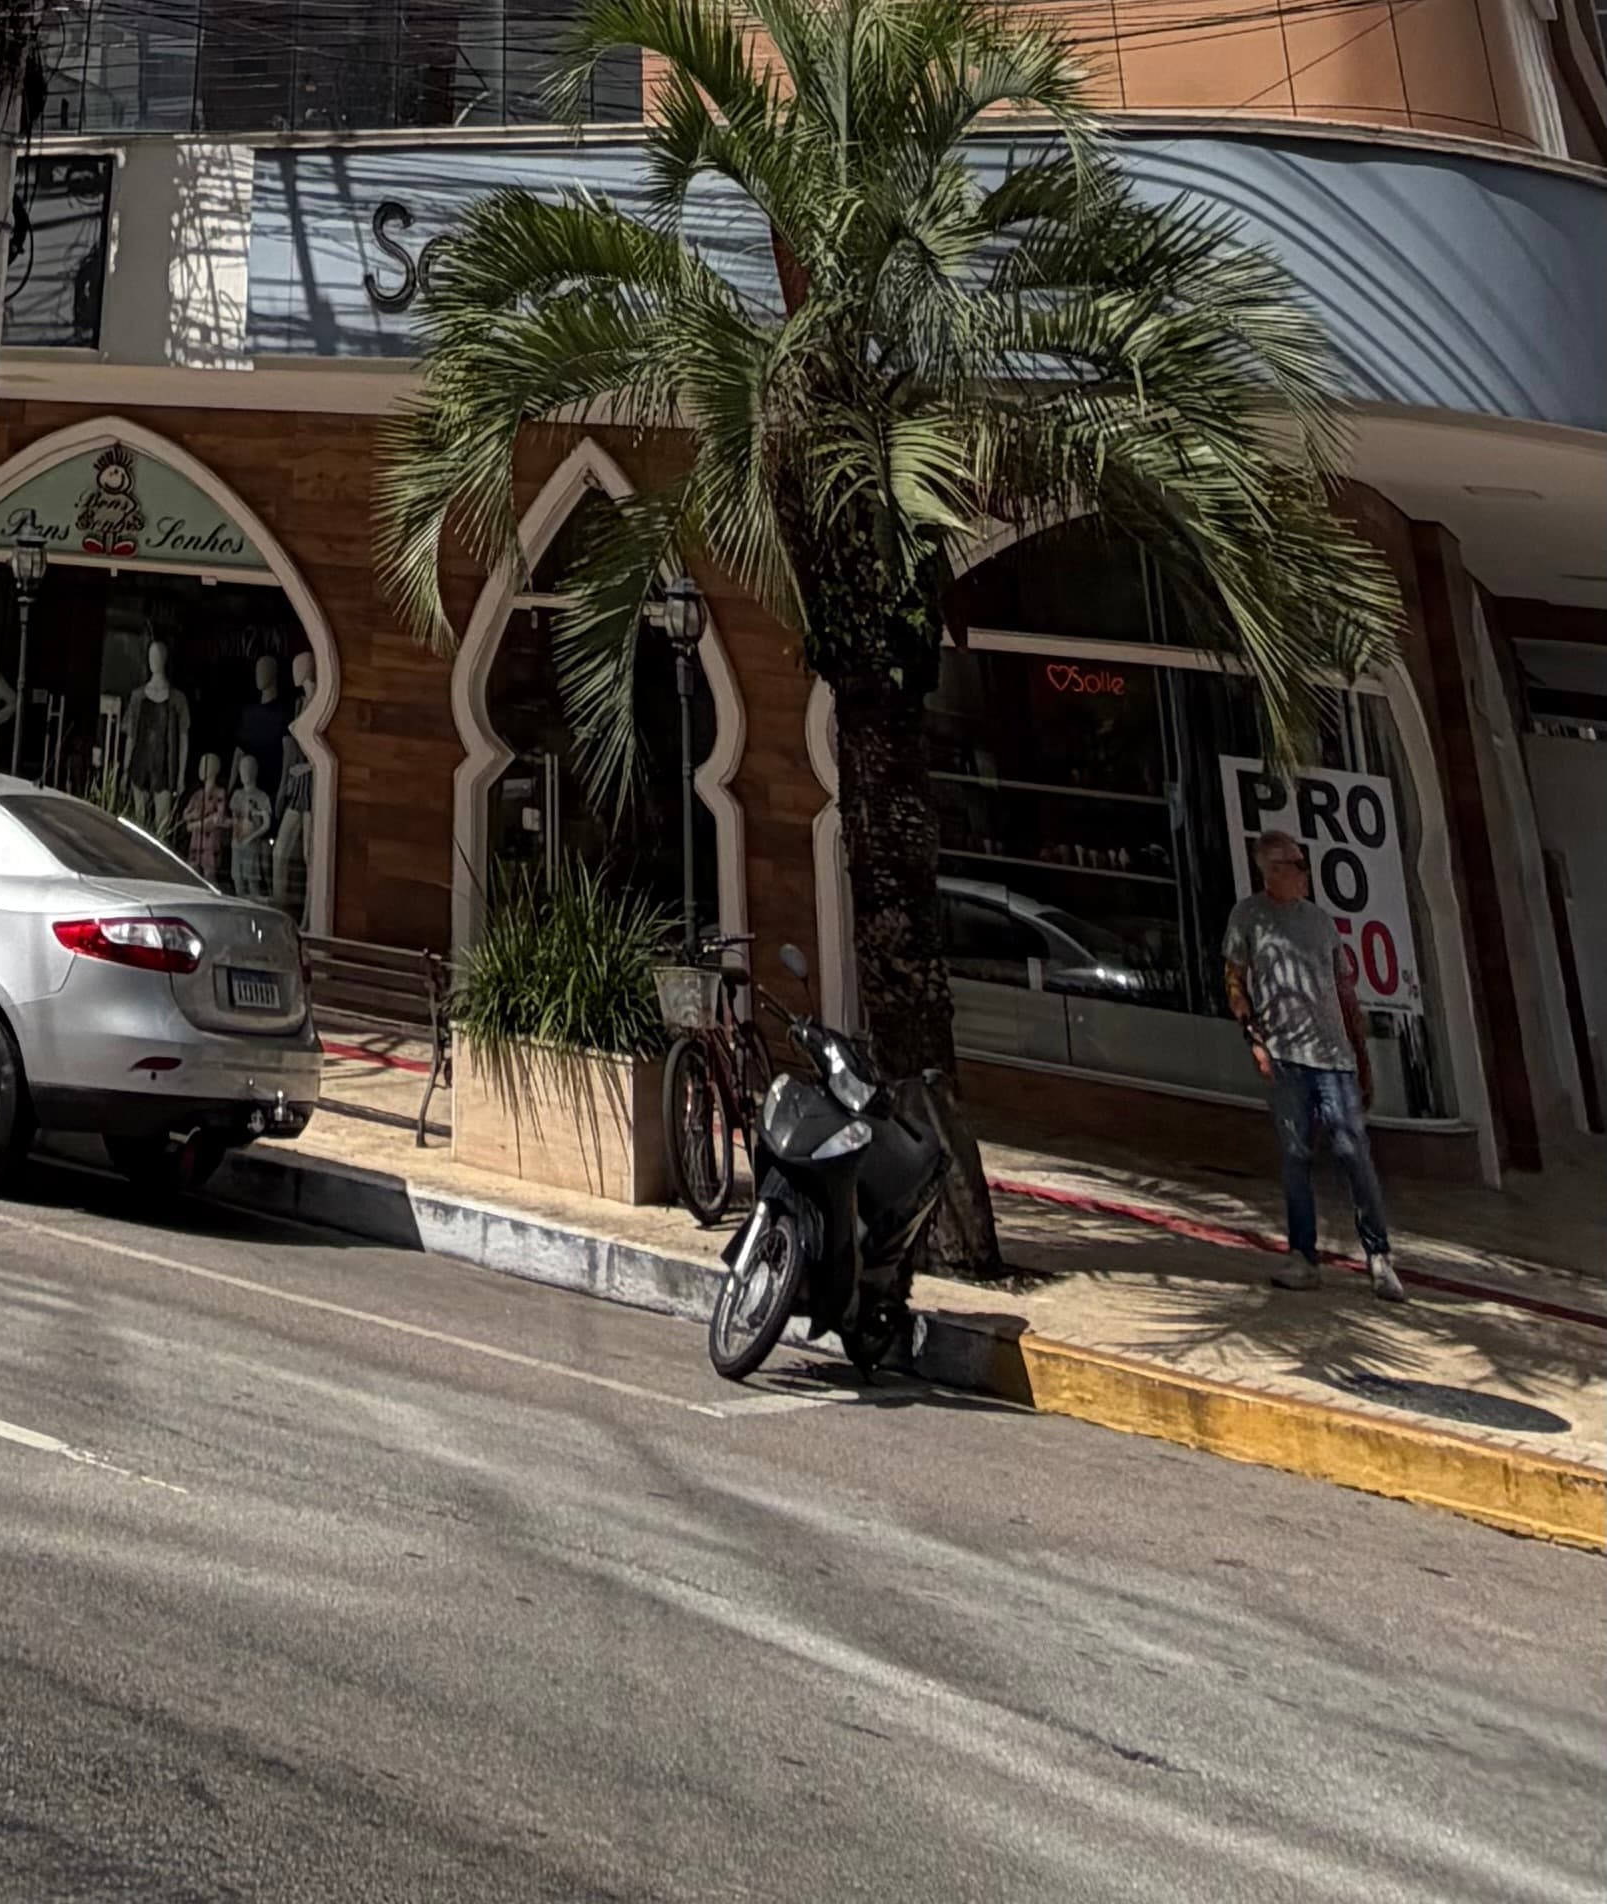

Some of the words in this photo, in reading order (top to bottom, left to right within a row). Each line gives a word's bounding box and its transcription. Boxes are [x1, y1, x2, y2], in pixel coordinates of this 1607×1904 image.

[146, 516, 244, 555] Sonhos
[1071, 665, 1125, 696] Solle
[1236, 768, 1387, 849] PRO
